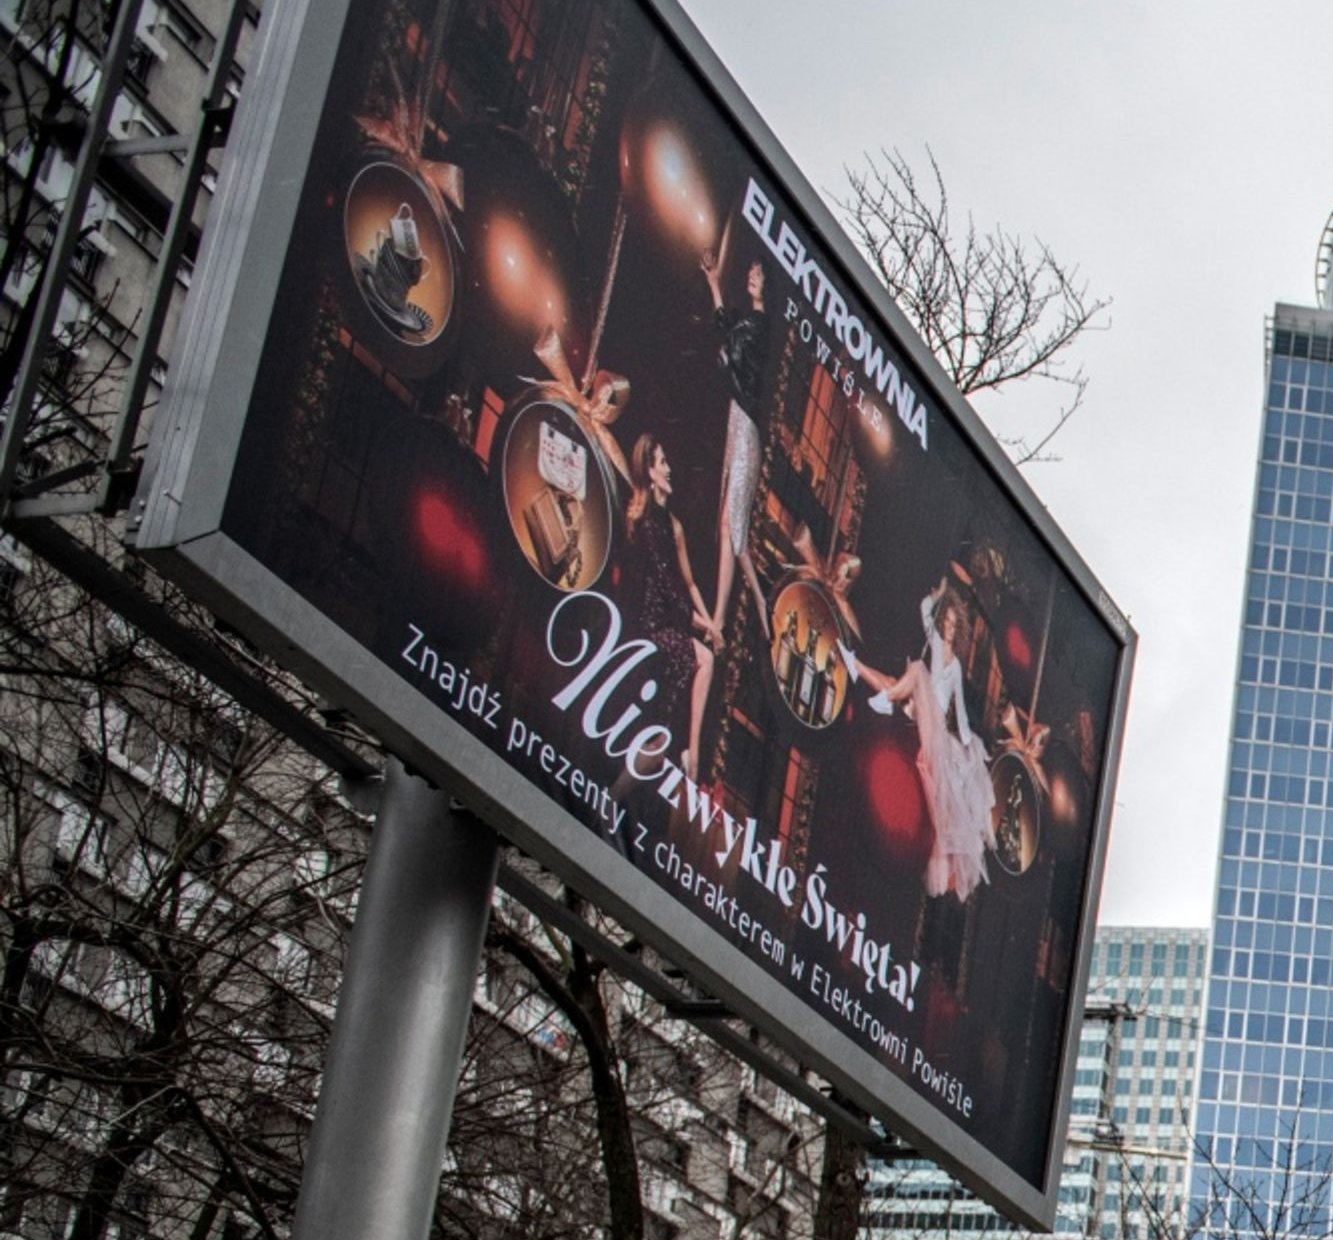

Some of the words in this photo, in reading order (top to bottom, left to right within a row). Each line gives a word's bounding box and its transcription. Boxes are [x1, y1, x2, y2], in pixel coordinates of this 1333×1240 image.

[742, 177, 928, 451] ELEKTROWNIA
[784, 297, 882, 432] POWIŚLE
[402, 622, 501, 729] Znajdź
[506, 718, 626, 834] prezenty
[633, 822, 648, 851] z
[654, 842, 785, 967] charakterem
[791, 954, 804, 981] w
[810, 963, 908, 1064] Elektrowni
[912, 1048, 973, 1117] Powiśle
[546, 590, 796, 907] Niezwykłe
[801, 863, 921, 1012] Święta!
